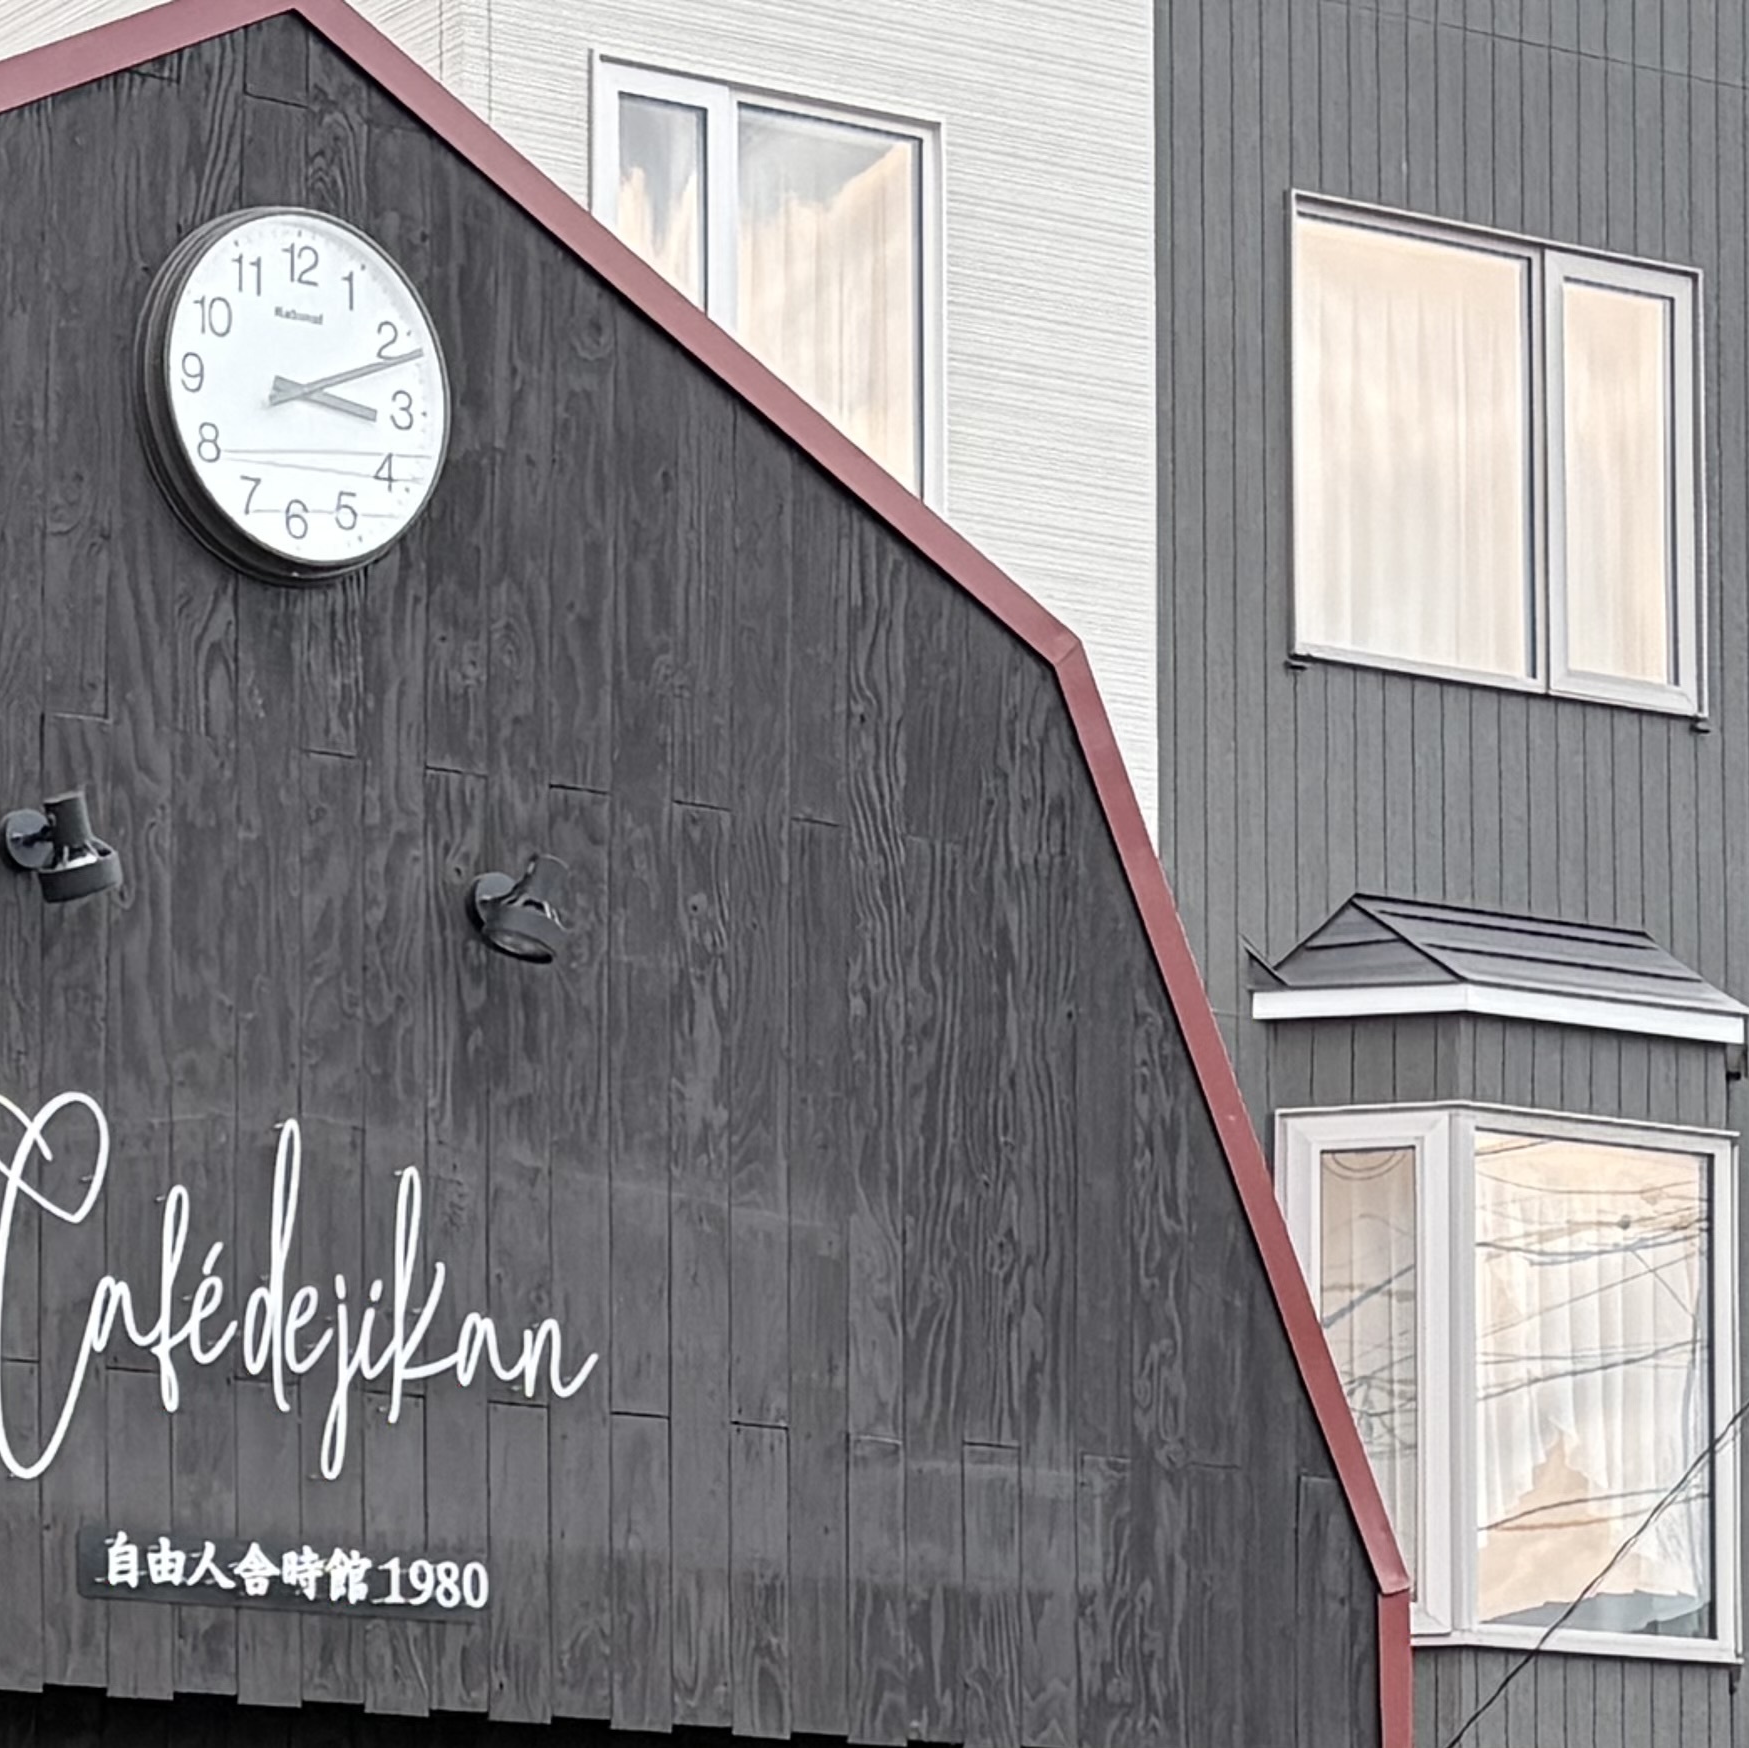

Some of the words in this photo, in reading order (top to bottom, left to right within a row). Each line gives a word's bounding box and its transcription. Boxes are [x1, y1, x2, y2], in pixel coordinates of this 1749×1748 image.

[231, 253, 263, 297] 11
[281, 243, 320, 287] 12
[341, 270, 355, 311] 1
[193, 295, 233, 337] 10
[376, 321, 399, 361] 2
[181, 352, 204, 393] 9
[390, 390, 414, 431] 3
[197, 422, 221, 463] 8
[373, 452, 395, 493] 4
[240, 475, 262, 515] 7
[335, 491, 358, 530] 5
[285, 499, 309, 540] 6
